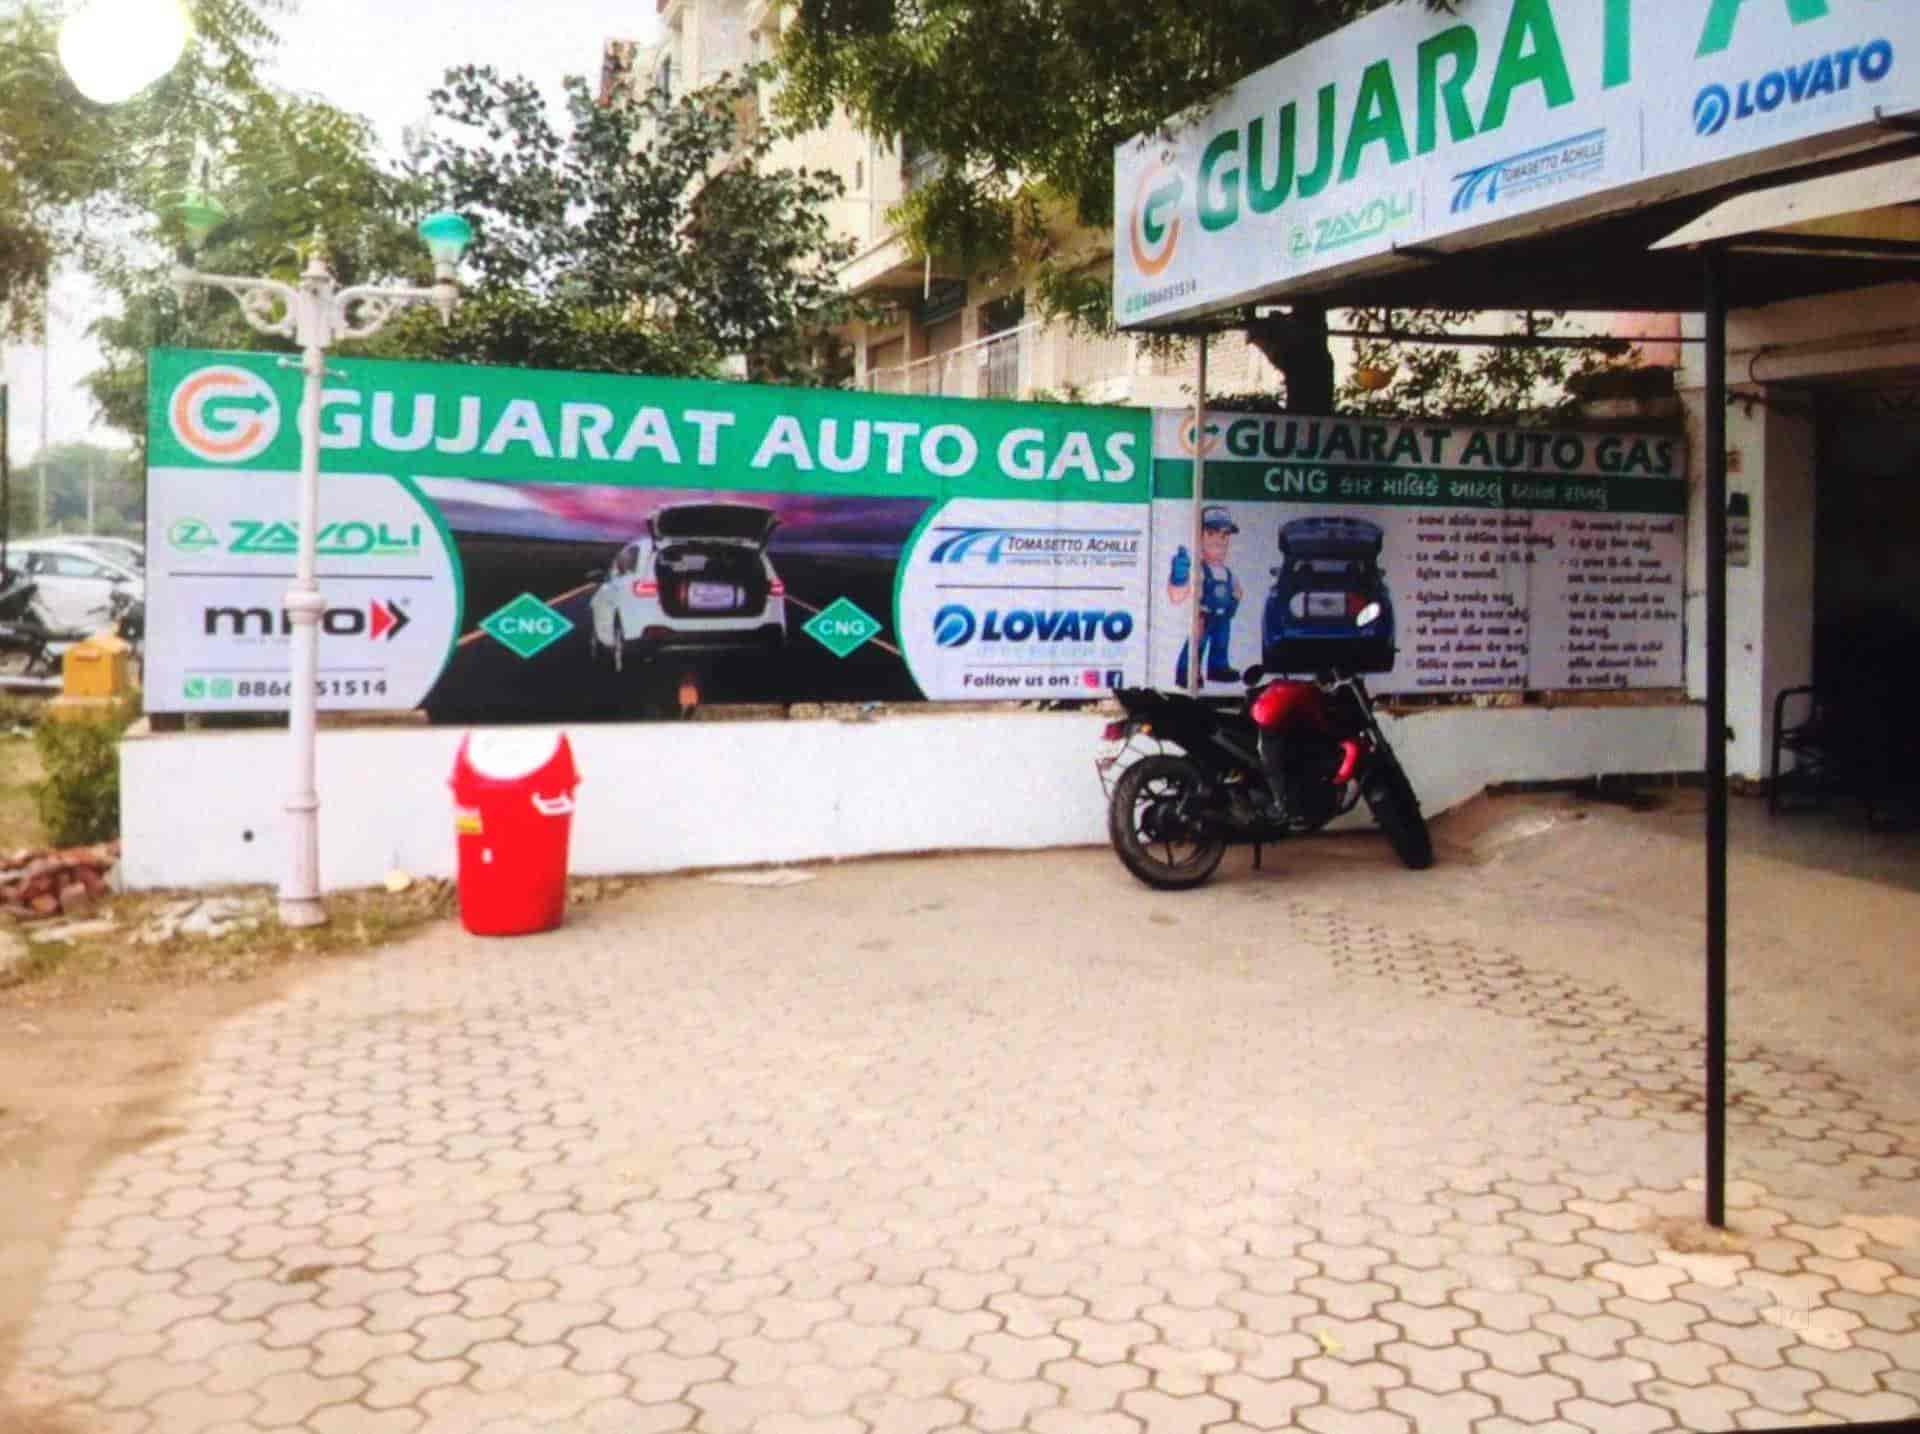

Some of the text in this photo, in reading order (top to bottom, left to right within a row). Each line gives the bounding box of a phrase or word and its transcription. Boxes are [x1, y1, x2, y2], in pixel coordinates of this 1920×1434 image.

[1735, 38, 1894, 119] LOVATO
[1314, 191, 1415, 254] ZAVOLI
[297, 388, 1137, 484] GUJARAT AUTO GAS
[1225, 418, 1674, 475] GUJARAT AUTO GAS
[1263, 467, 1329, 493] CNG
[228, 520, 421, 556] ZAVOLI
[1007, 535, 1137, 554] TOMASETTO ACHILLE
[499, 617, 555, 635] CNG
[818, 620, 866, 636] CNG
[980, 609, 1134, 643] LOVATO
[237, 679, 388, 697] 886651514
[963, 672, 1021, 689] Follow
[1025, 674, 1044, 688] us
[1049, 674, 1070, 688] on
